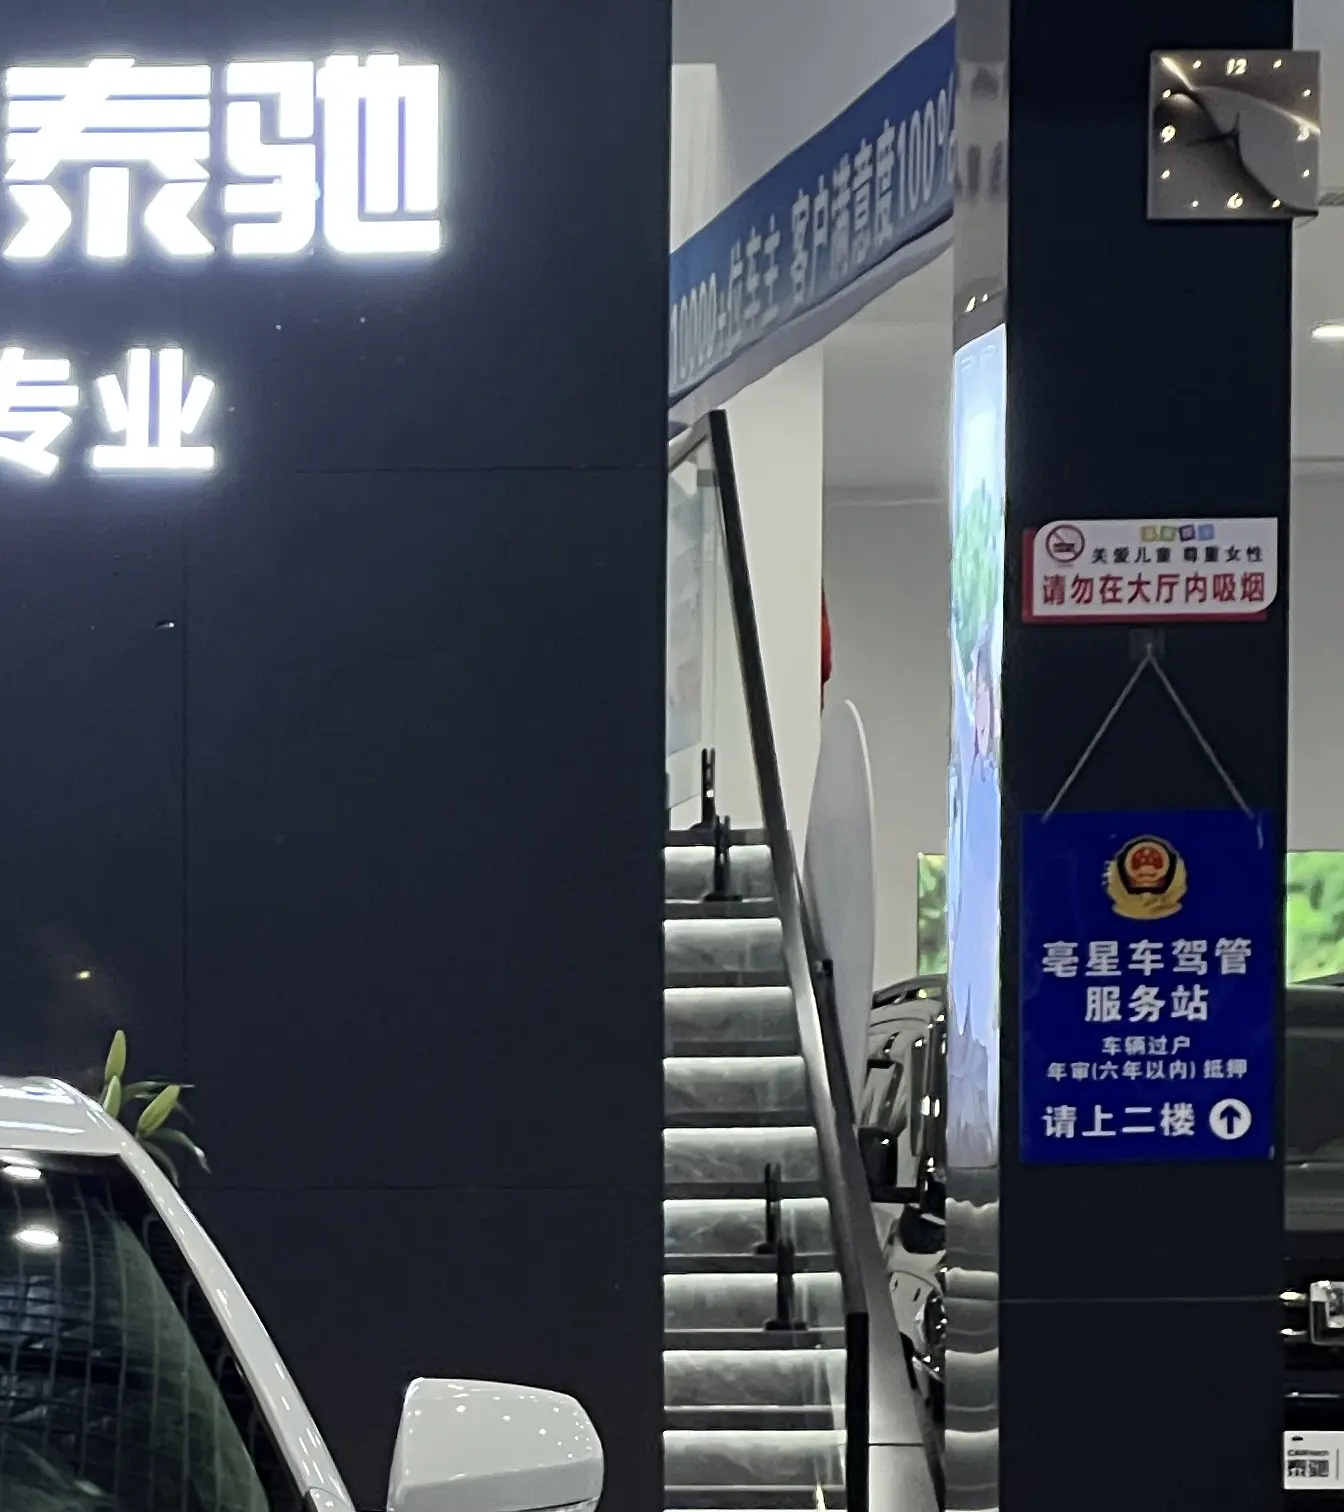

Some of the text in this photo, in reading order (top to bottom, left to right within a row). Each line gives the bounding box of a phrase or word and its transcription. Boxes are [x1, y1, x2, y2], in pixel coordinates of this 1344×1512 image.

[1226, 58, 1247, 75] 12
[1161, 124, 1176, 143] 9
[1226, 192, 1244, 209] 6
[1042, 571, 1265, 605] 请勿在大厅内吸烟
[1084, 983, 1209, 1023] 服务站
[1101, 1035, 1191, 1056] 车辆过户
[1041, 1102, 1195, 1139] 请上二楼
